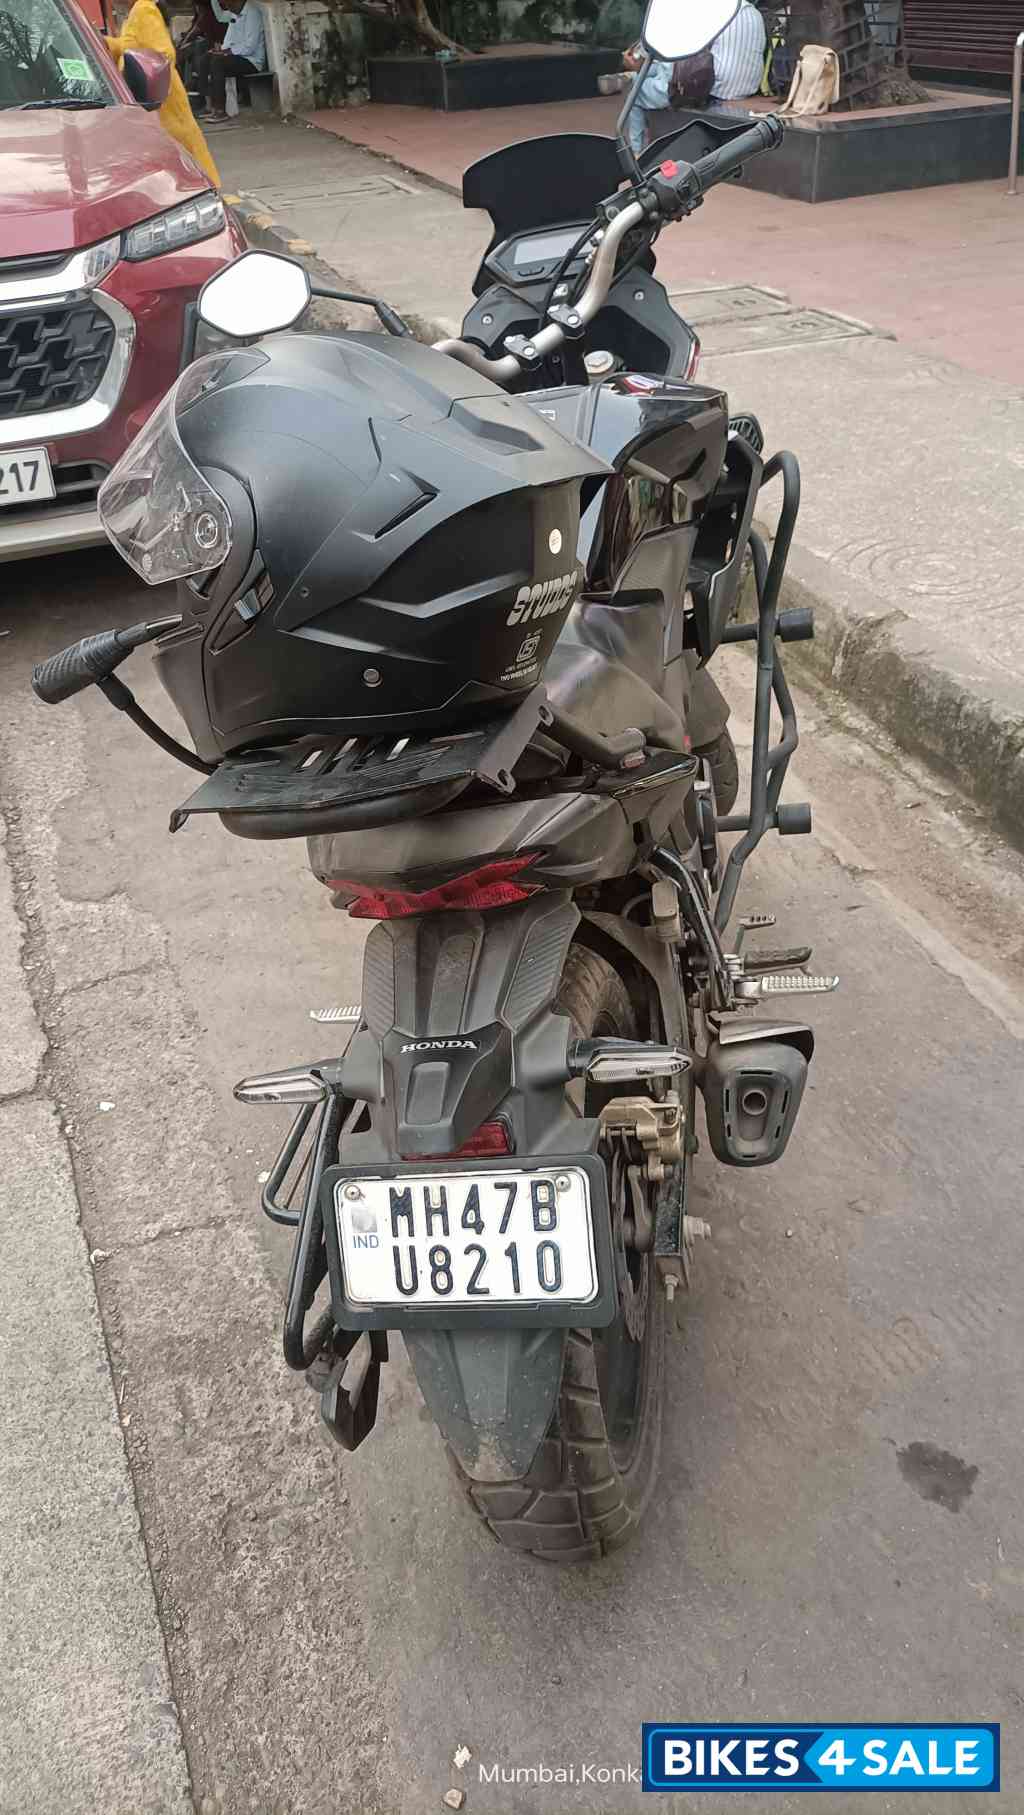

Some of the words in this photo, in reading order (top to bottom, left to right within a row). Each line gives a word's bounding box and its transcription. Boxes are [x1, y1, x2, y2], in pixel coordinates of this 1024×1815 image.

[400, 1040, 477, 1053] HONDA
[389, 1179, 558, 1238] MH47B
[352, 1234, 379, 1249] IND
[392, 1239, 562, 1296] U8210
